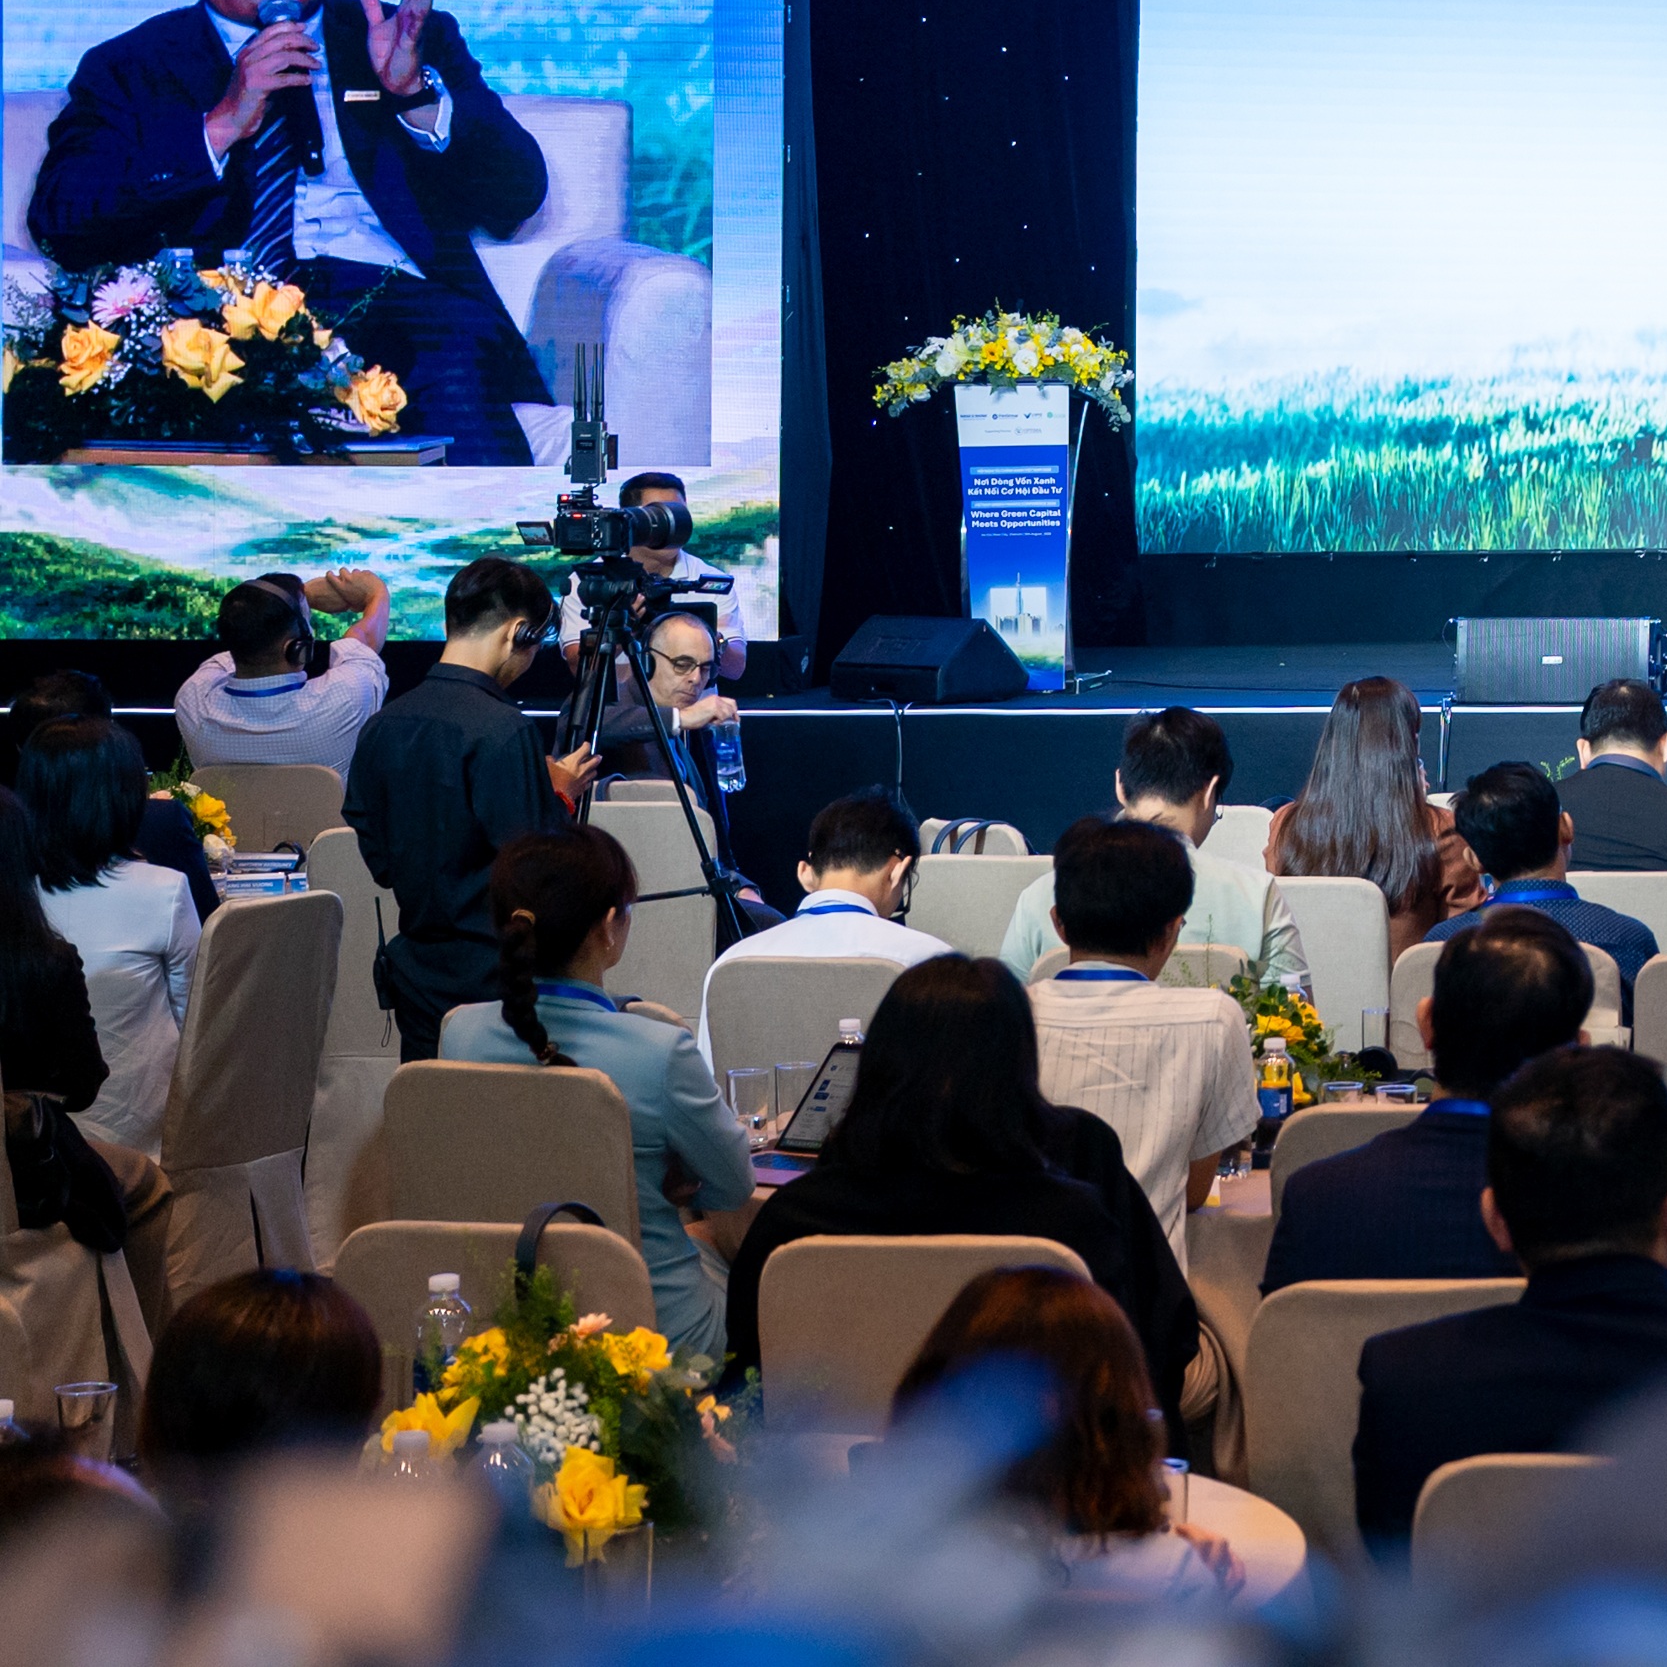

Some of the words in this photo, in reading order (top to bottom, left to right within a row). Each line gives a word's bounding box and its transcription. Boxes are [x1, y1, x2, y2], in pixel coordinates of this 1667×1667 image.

[970, 510, 999, 519] Where
[1001, 509, 1028, 518] Green
[1029, 509, 1061, 518] Capital
[971, 520, 998, 528] Meets
[1000, 519, 1061, 529] Opportunities
